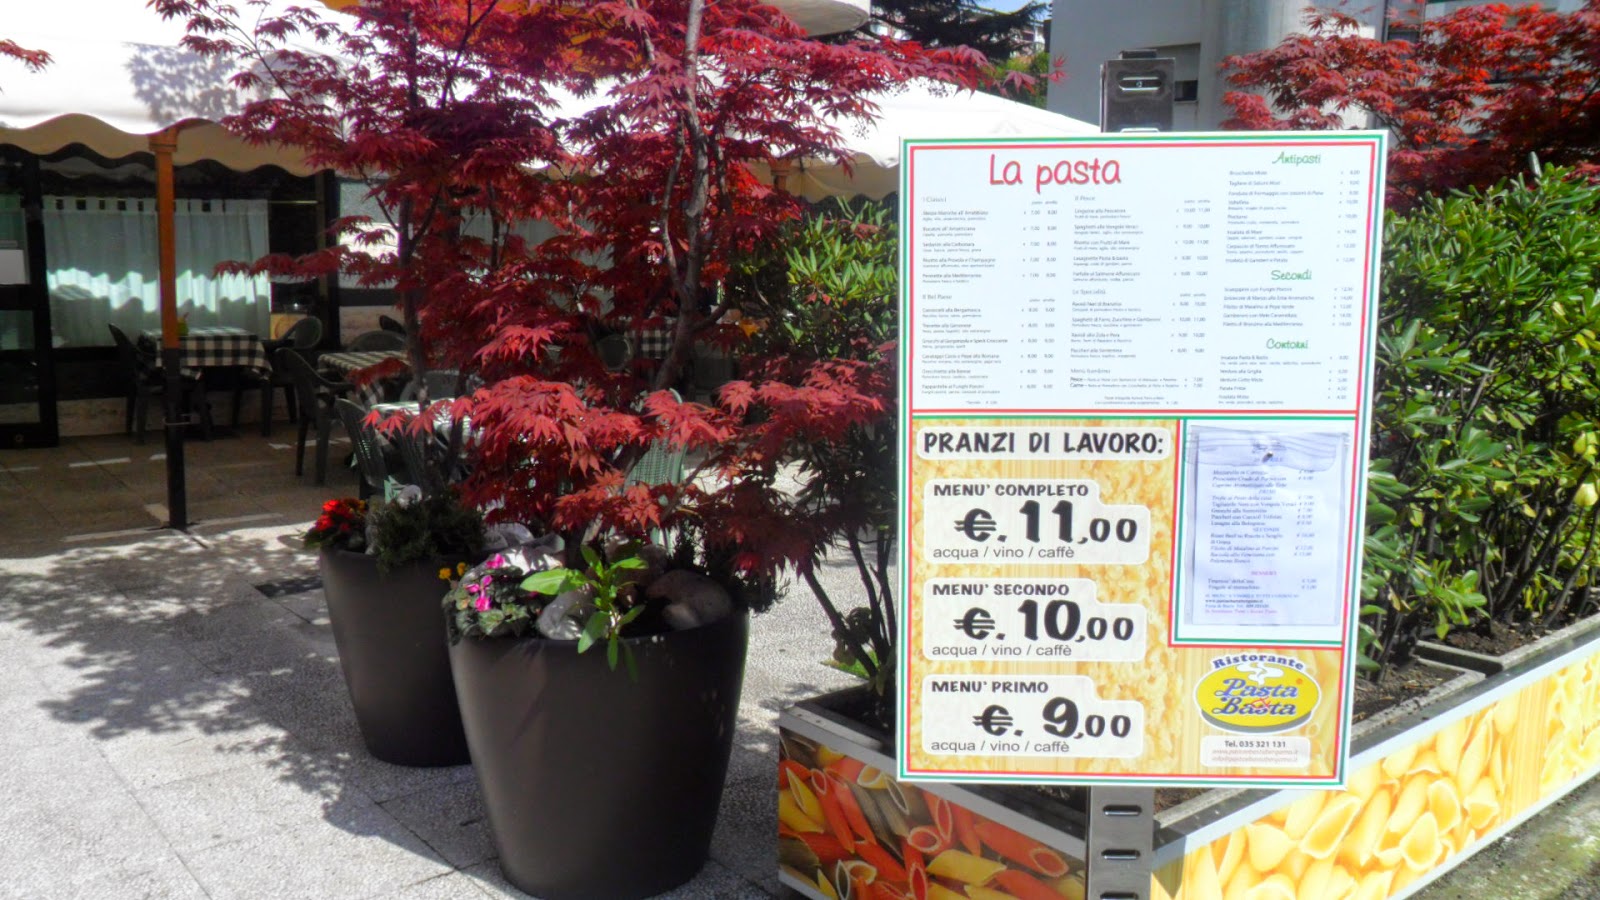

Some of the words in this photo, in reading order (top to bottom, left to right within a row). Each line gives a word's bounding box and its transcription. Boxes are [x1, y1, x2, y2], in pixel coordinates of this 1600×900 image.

[1272, 151, 1321, 167] Antipasti
[990, 154, 1023, 186] La
[1036, 157, 1122, 195] pasta
[1271, 268, 1312, 281] Secondi
[1266, 338, 1308, 349] Contorni
[923, 432, 1015, 454] PRANZI
[1029, 432, 1050, 454] DI
[1063, 432, 1164, 454] LAVORO:
[933, 484, 990, 497] MENU'
[995, 484, 1089, 497] COMPLETO
[933, 547, 978, 560] acqua
[993, 547, 1024, 558] vino
[1038, 546, 1075, 559] caffè
[932, 584, 989, 596] MENU'
[993, 584, 1070, 596] SECONDO
[932, 646, 977, 657] acqua
[991, 645, 1022, 656] vino
[1036, 644, 1072, 656] caffè
[1212, 653, 1304, 671] Ristorante
[931, 681, 988, 693] MENU'
[991, 681, 1049, 693] PRIMO
[1214, 677, 1298, 698] Pasta
[1212, 696, 1297, 715] Basta
[931, 740, 976, 753] acqua
[990, 740, 1020, 751] vino
[1034, 740, 1070, 753] caffè
[1224, 740, 1238, 748] Tel.
[1239, 740, 1254, 748] 035
[1255, 740, 1270, 748] 321
[1272, 740, 1287, 748] 131
